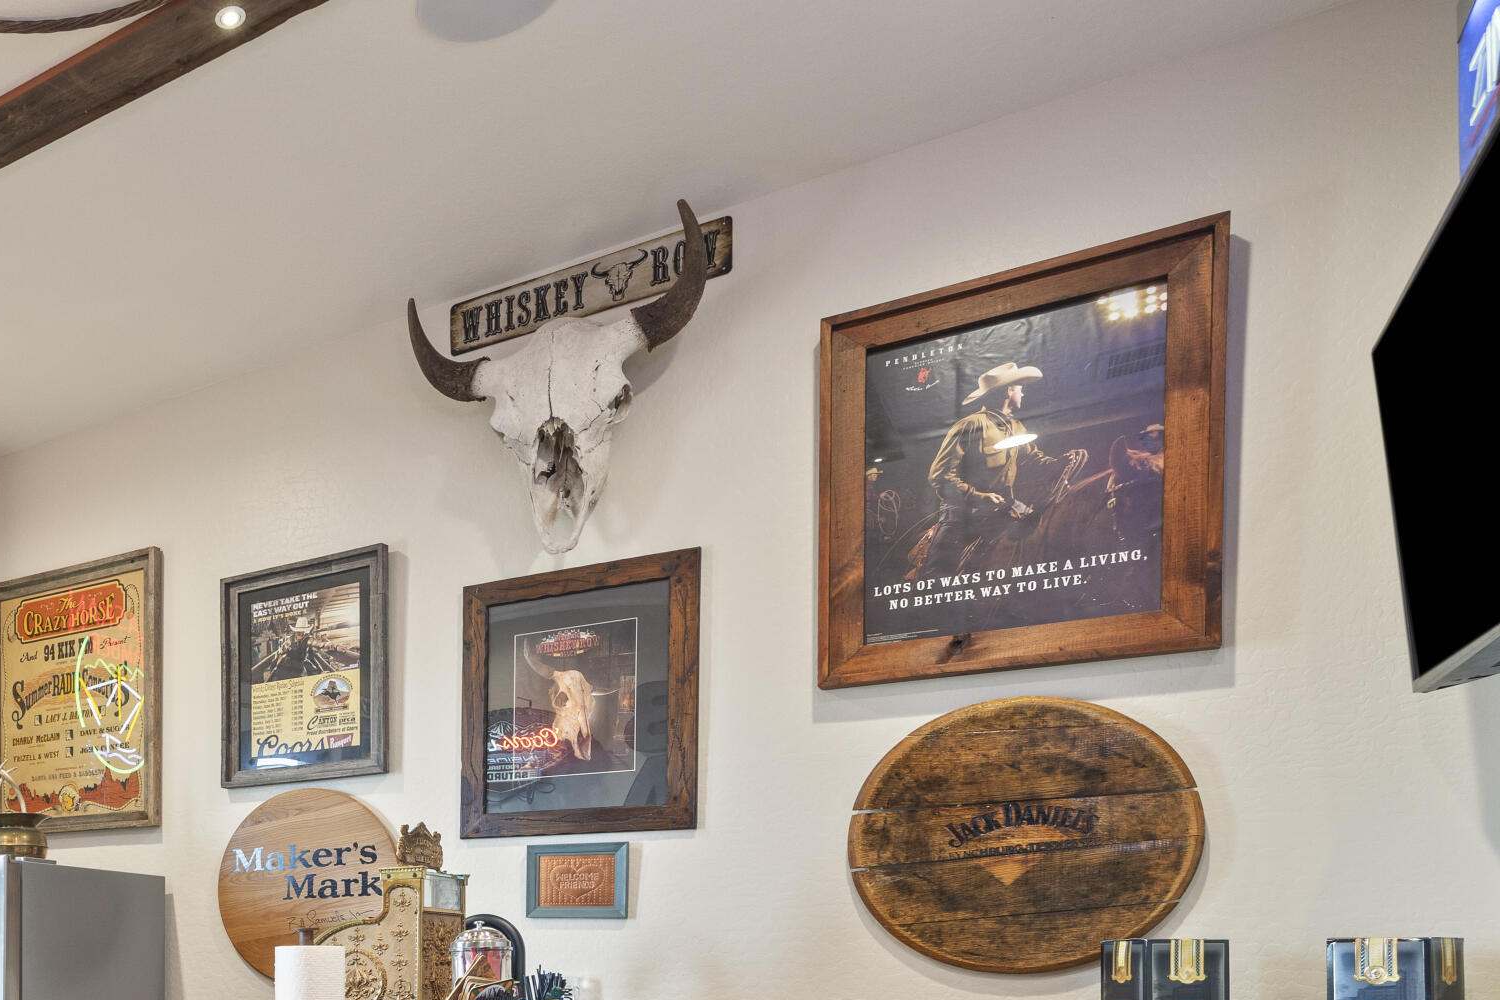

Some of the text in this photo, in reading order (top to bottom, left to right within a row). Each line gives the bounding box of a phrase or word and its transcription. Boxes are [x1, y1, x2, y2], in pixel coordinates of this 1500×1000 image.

[461, 271, 589, 344] WHISKEY
[885, 343, 963, 367] PENDLETON
[874, 548, 1148, 597] LOTS OF WAYS TO MAKE A LIVING,
[252, 591, 318, 611] NEVER TAKE THE
[888, 573, 1088, 611] NO BETTER WAY TO LIVE.
[23, 592, 115, 637] CRAZY HORSE
[57, 597, 79, 613] The
[252, 607, 274, 618] EASY
[274, 604, 292, 614] WAY
[293, 600, 310, 610] OUT
[20, 650, 38, 663] And
[43, 643, 56, 662] 94
[57, 639, 75, 660] KIX
[536, 639, 577, 654] WHISKEY
[12, 679, 53, 730] Summer
[12, 735, 35, 747] CHARLY
[80, 728, 98, 737] DAVE
[256, 734, 326, 758] Coors
[44, 750, 60, 760] WEST
[945, 811, 1003, 848] JACK
[232, 841, 378, 873] Maker's
[283, 871, 382, 900] Mark
[555, 872, 600, 881] WELCOME
[559, 880, 596, 889] FRIENDS
